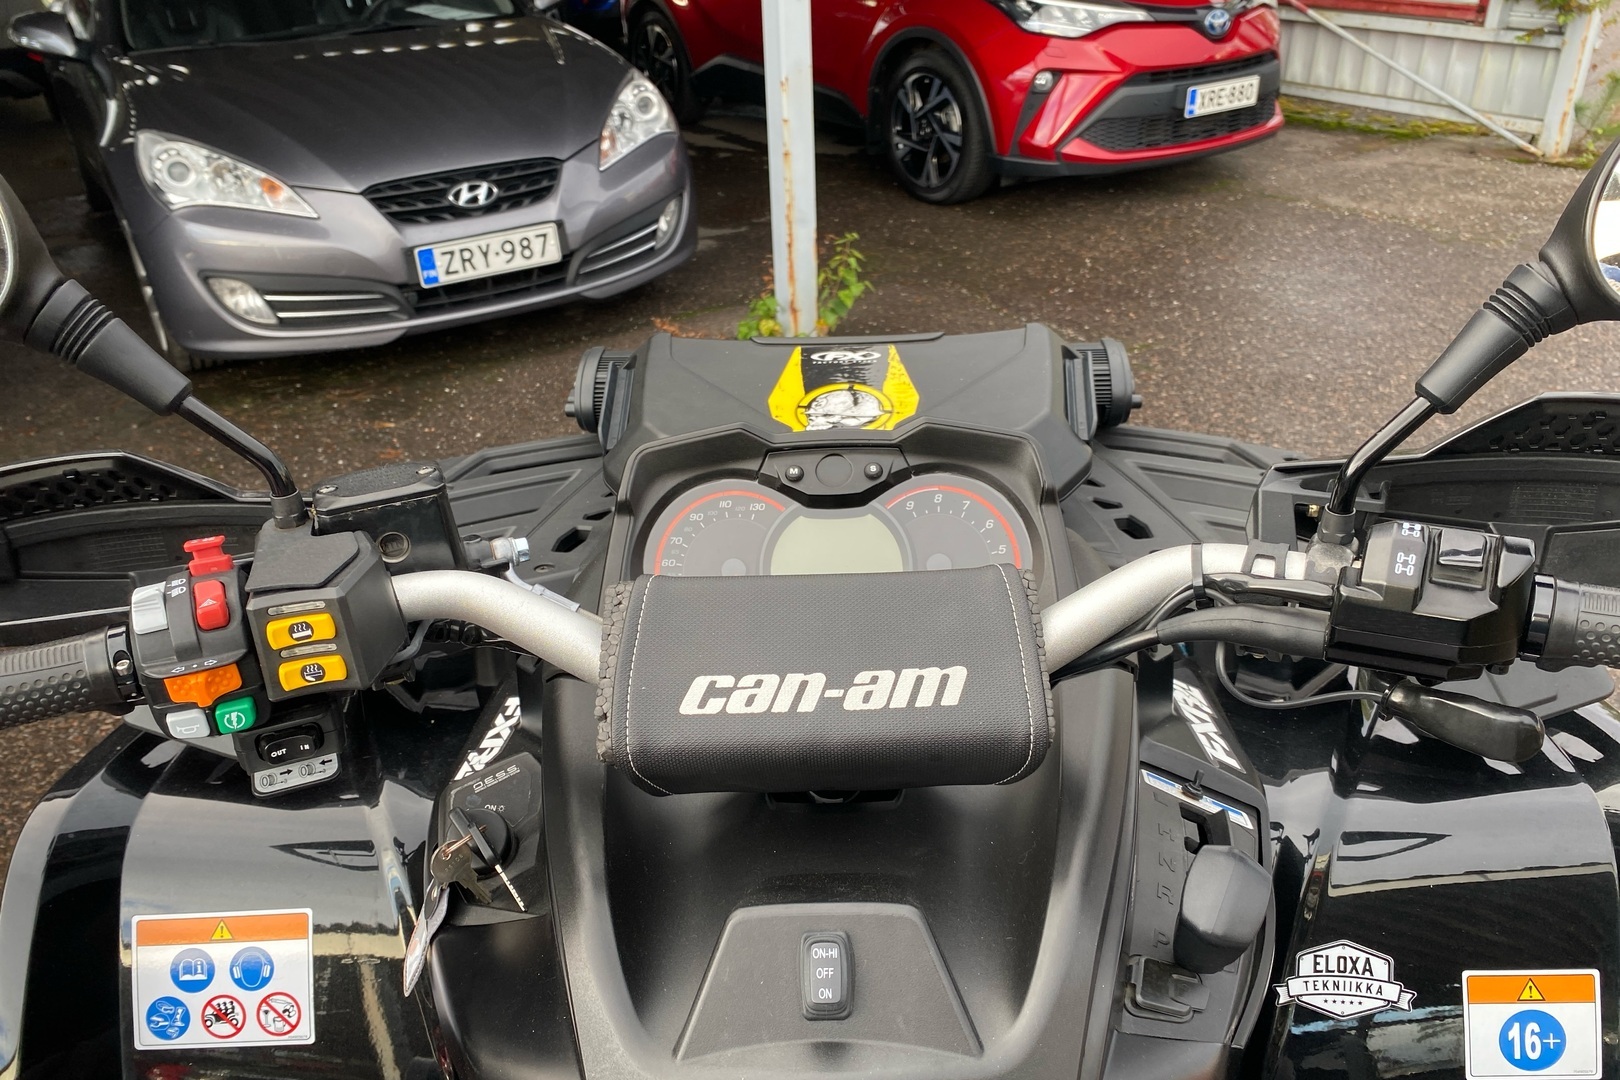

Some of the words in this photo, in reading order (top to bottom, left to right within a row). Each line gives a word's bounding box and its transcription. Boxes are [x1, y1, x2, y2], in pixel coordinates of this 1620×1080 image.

[441, 233, 548, 276] ZRY-987
[789, 467, 798, 475] M
[934, 494, 943, 503] 8
[719, 500, 732, 508] 110
[749, 503, 765, 511] 130
[905, 501, 914, 511] 9
[962, 501, 971, 510] 7
[689, 513, 704, 521] 90
[985, 519, 994, 529] 6
[670, 537, 683, 545] 70
[998, 545, 1006, 554] 5
[661, 559, 676, 567] 60
[679, 666, 968, 715] can-am
[270, 748, 287, 758] OUT
[812, 947, 838, 959] ON-HI
[1313, 954, 1374, 977] ELOXA
[816, 967, 835, 979] OFF
[818, 987, 833, 999] ON
[1303, 980, 1384, 996] TEKNIIKKA
[1507, 1022, 1561, 1060] 16+
